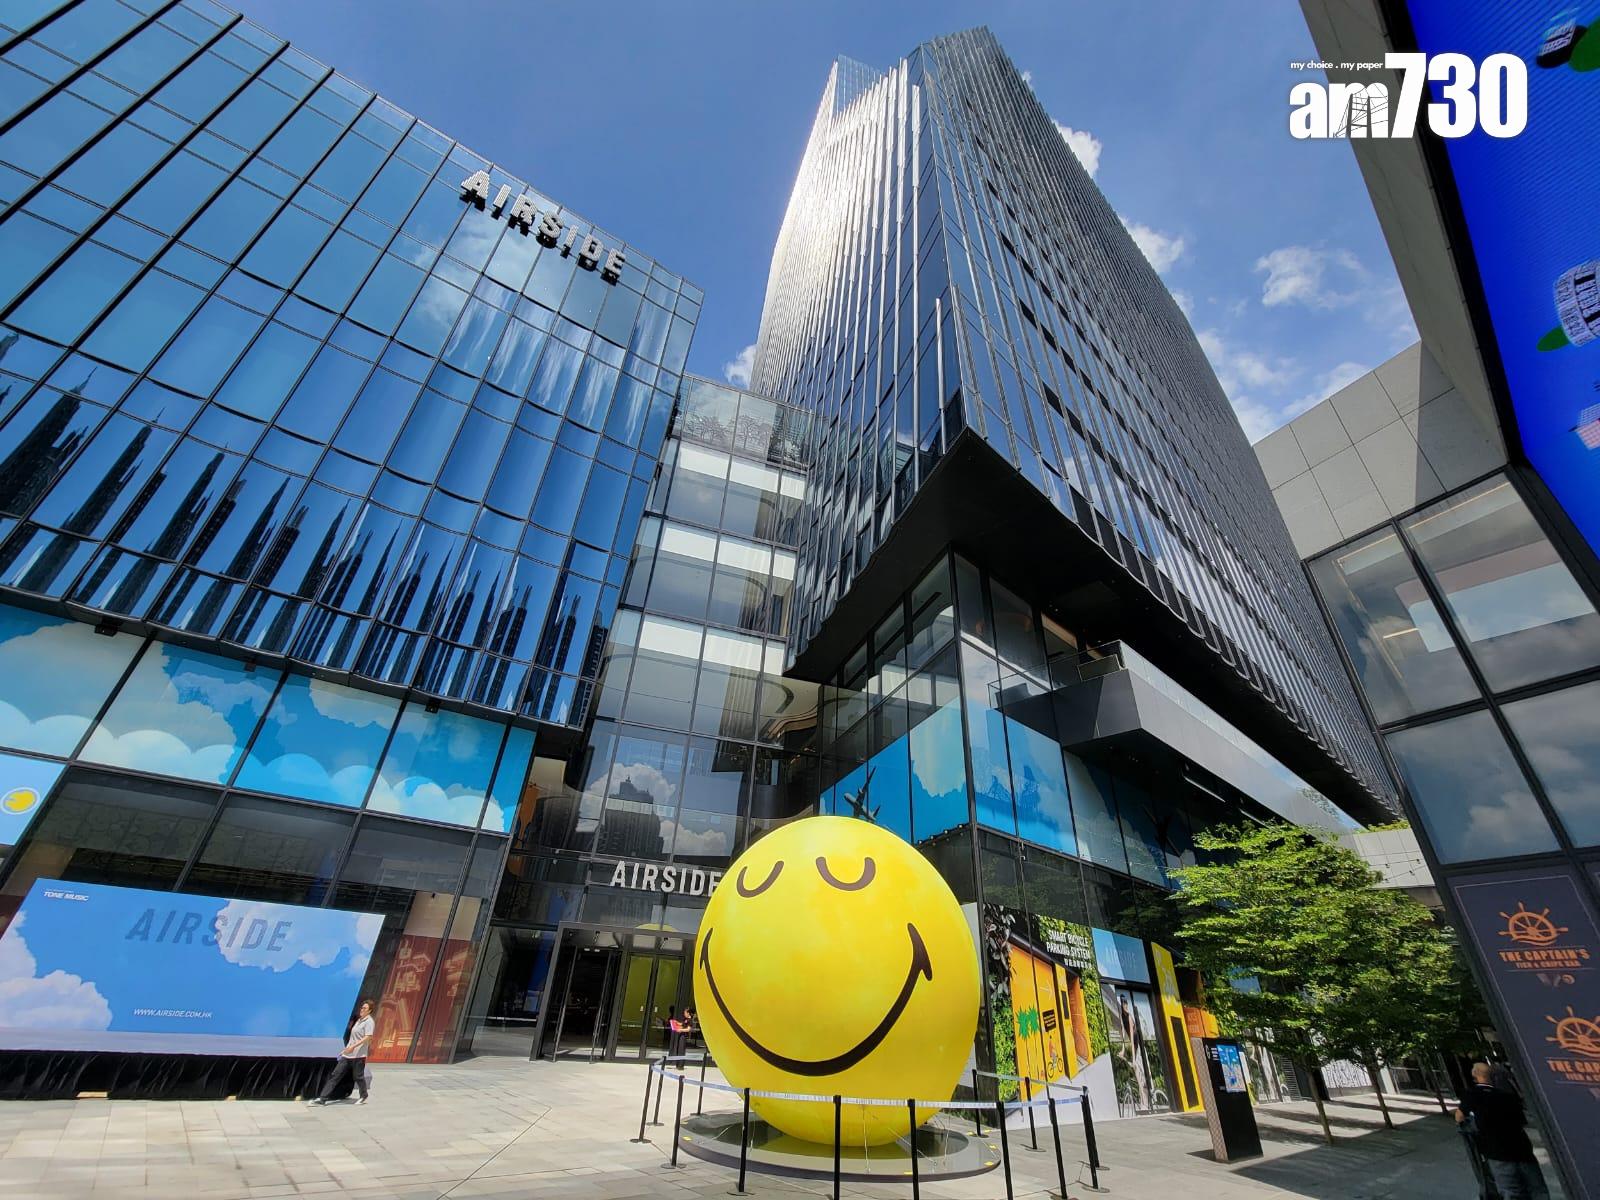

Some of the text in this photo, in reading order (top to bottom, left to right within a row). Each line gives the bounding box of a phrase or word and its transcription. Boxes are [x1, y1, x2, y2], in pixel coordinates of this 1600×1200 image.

[460, 170, 626, 286] AIRSIDE
[609, 860, 723, 897] AIRSIDE
[125, 908, 293, 952] AIRSIDE
[1499, 948, 1590, 962] THE CAPTAIN'S
[1547, 1060, 1573, 1072] THE
